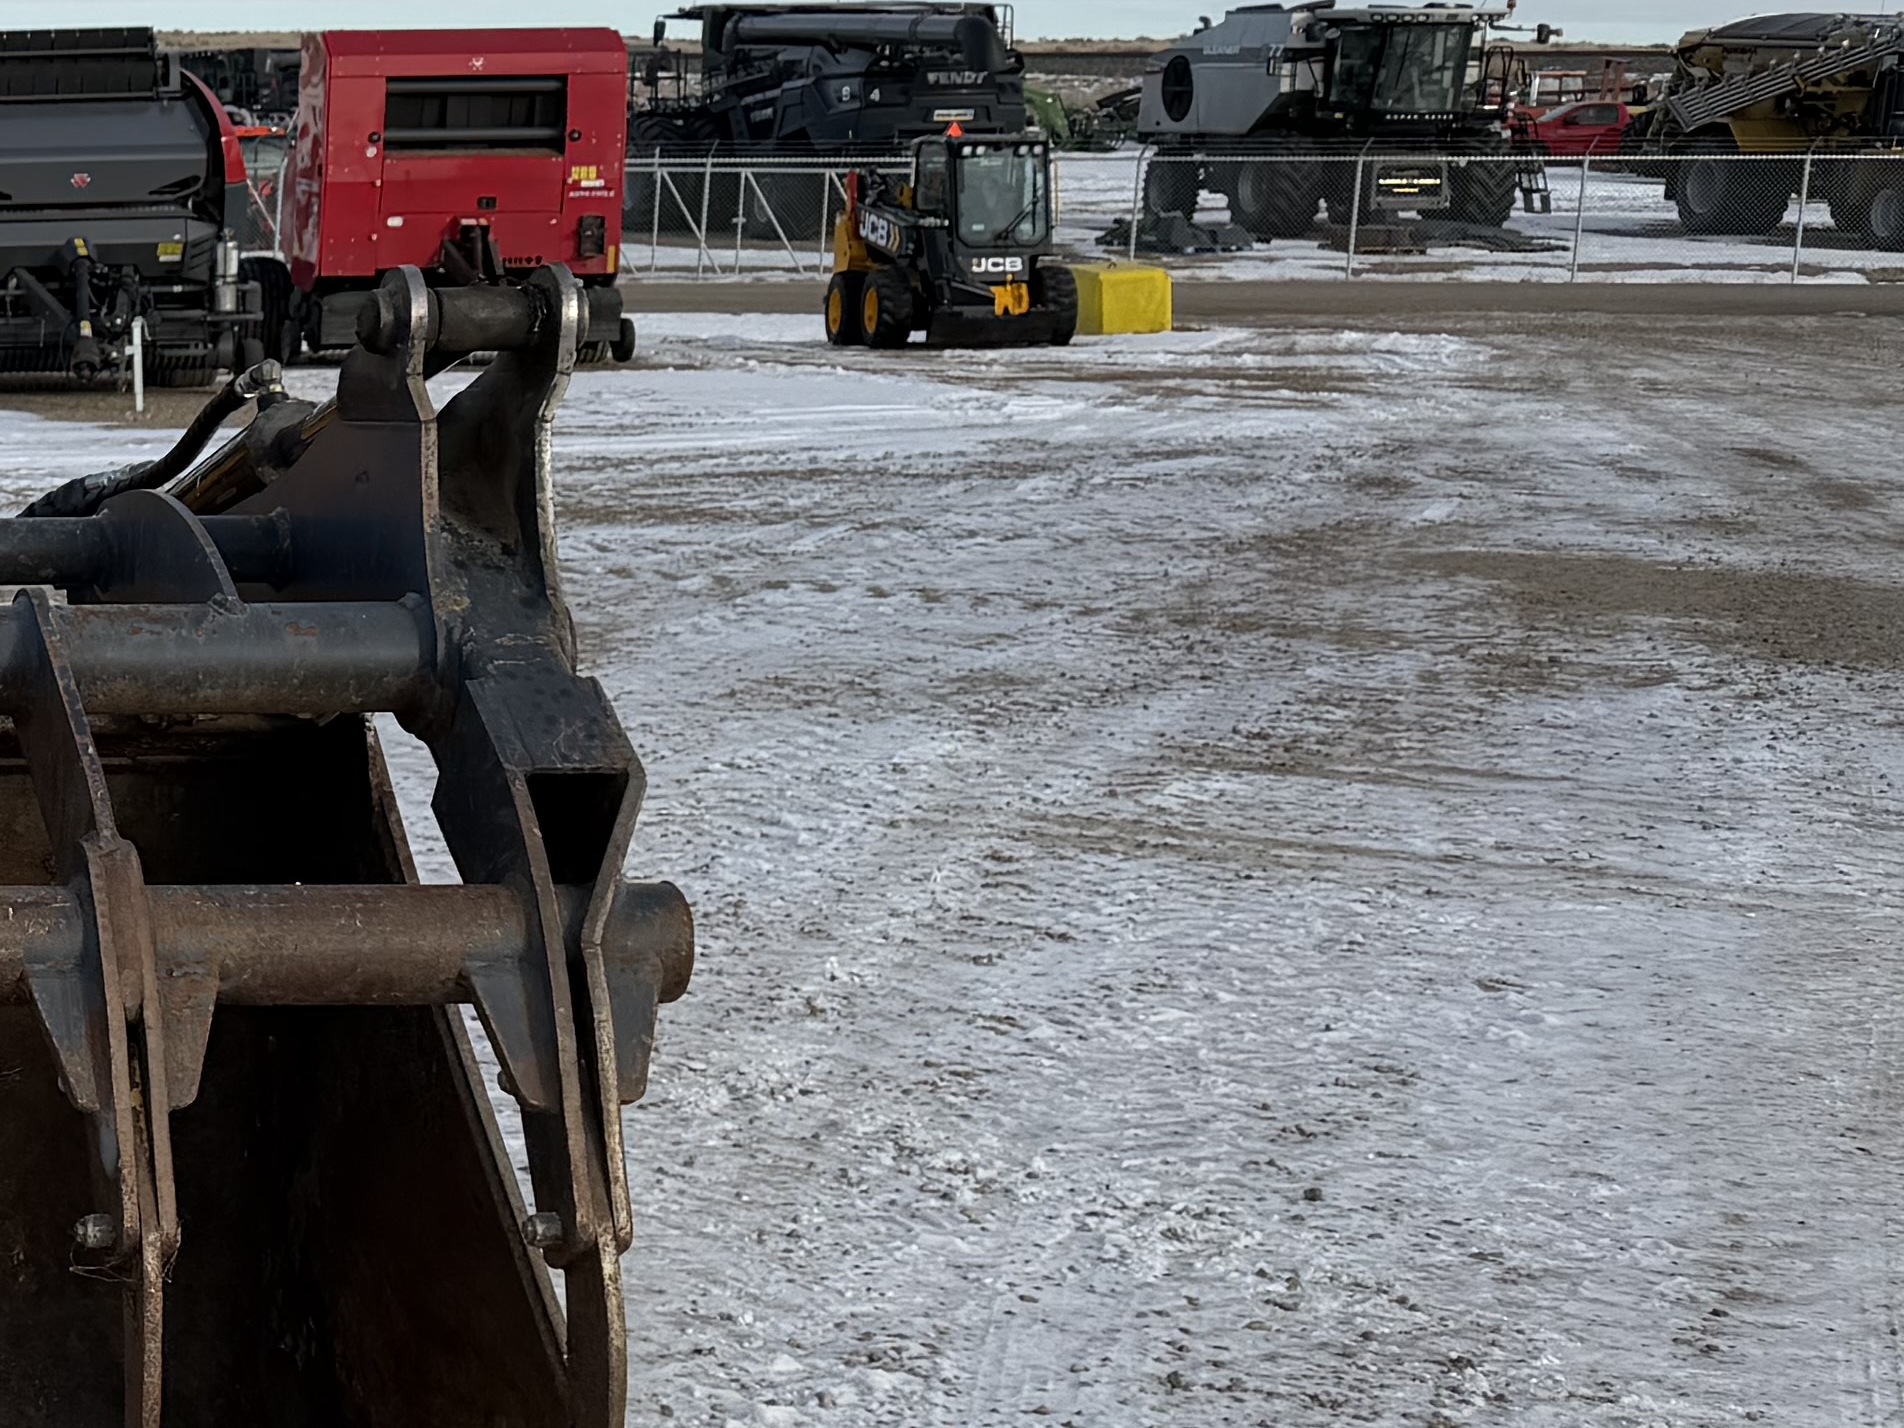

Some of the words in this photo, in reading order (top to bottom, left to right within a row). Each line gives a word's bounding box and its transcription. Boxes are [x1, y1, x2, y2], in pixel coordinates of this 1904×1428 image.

[927, 70, 989, 85] FENDT
[859, 210, 889, 247] JCB
[971, 256, 1024, 273] JCB
